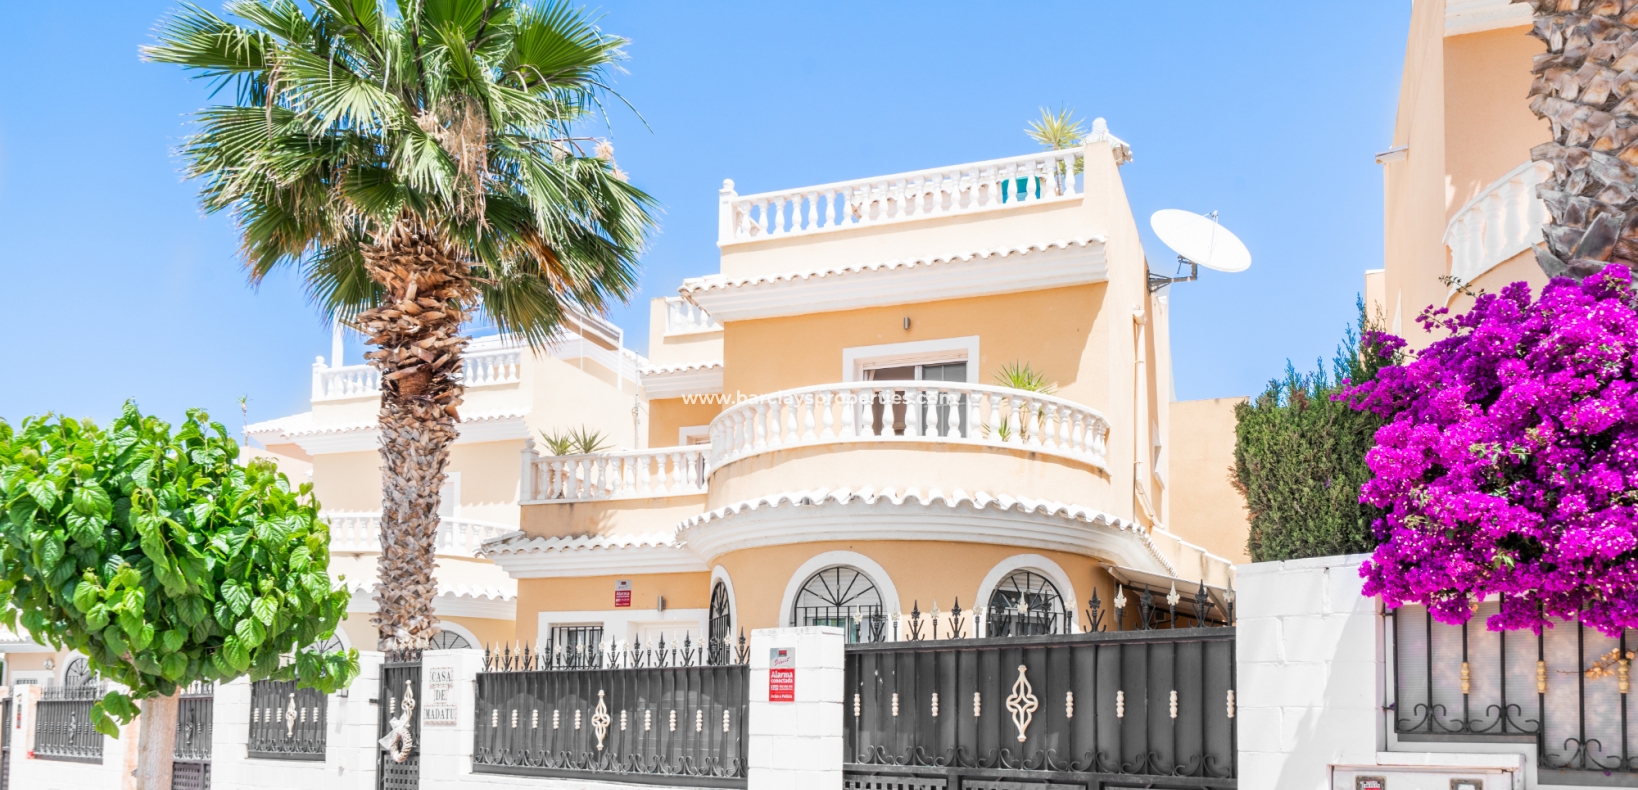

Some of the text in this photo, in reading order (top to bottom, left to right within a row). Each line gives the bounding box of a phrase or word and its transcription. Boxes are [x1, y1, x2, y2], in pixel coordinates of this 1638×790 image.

[431, 671, 453, 682] CASA
[770, 670, 793, 679] Alarma
[435, 689, 446, 701] DE
